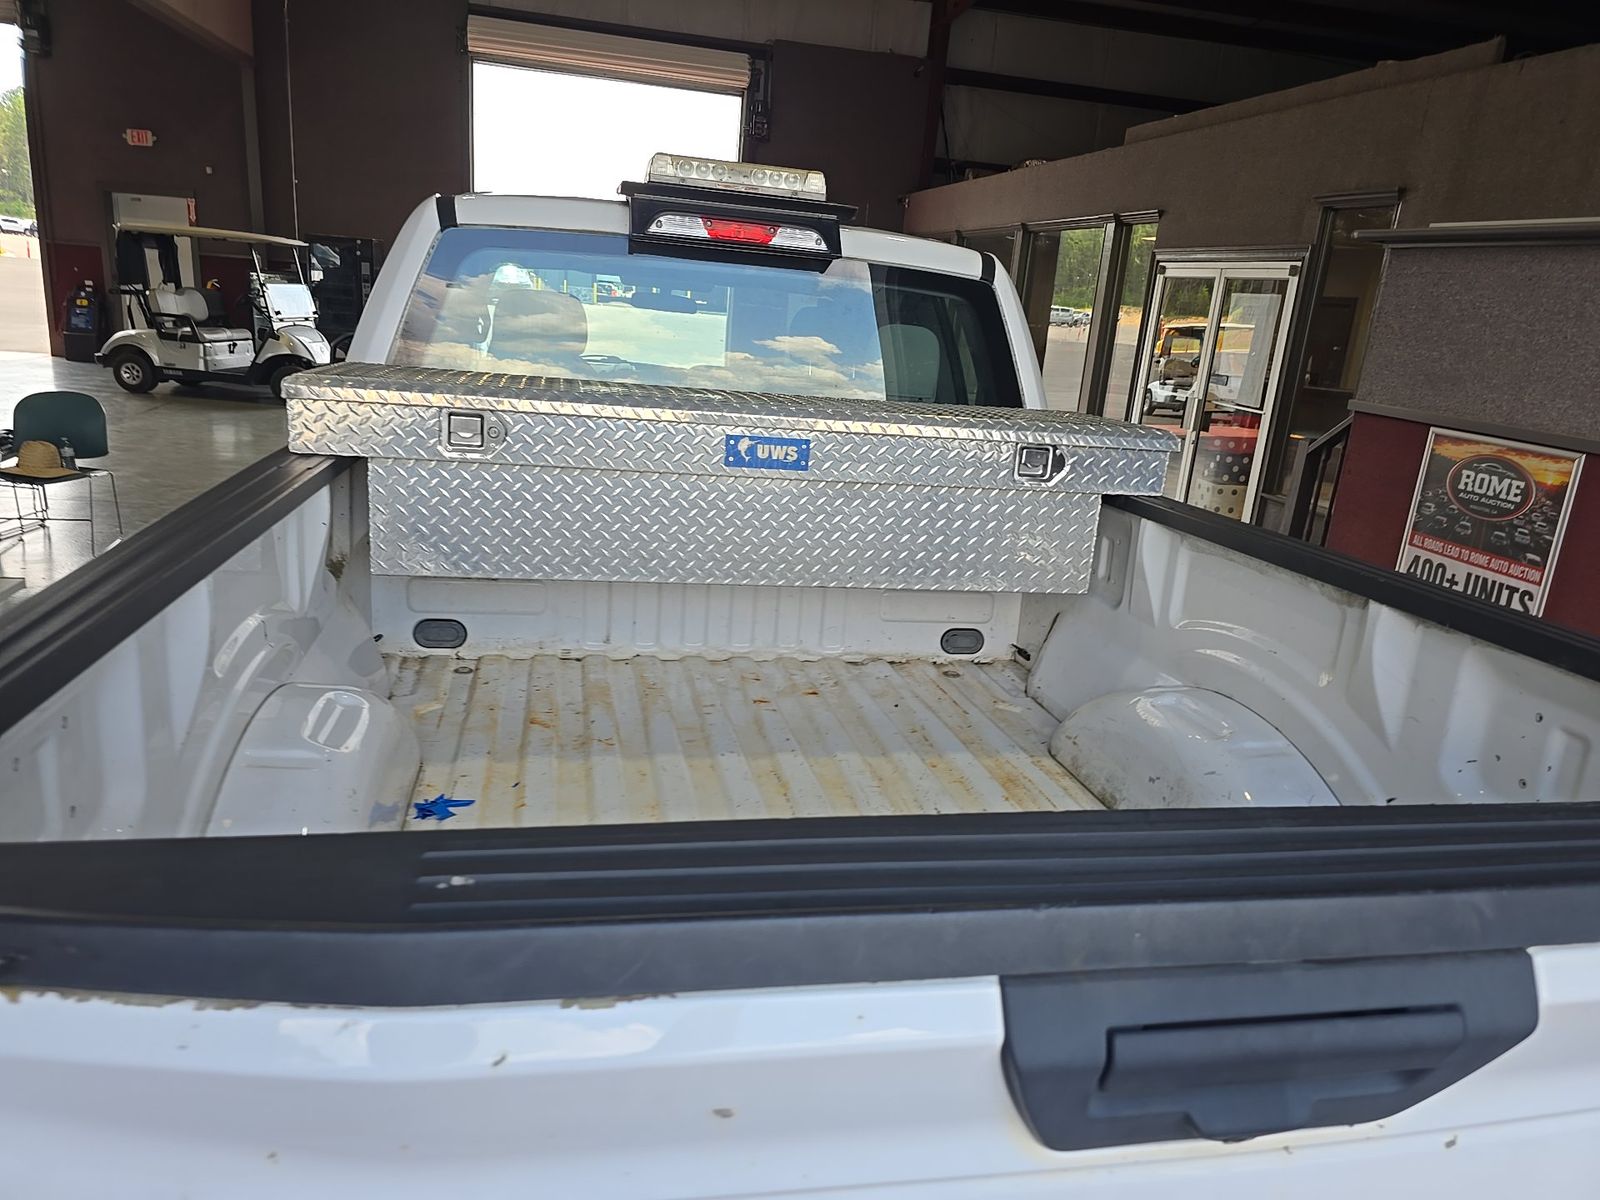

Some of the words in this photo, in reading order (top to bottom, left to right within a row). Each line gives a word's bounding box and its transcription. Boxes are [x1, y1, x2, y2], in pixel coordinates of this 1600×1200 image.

[757, 444, 798, 461] UWS
[1458, 469, 1526, 503] ROME
[1459, 492, 1480, 502] AUTO
[1480, 497, 1515, 510] AUCTION
[1412, 534, 1424, 547] ALL
[1423, 537, 1444, 553] ROADS
[1443, 543, 1460, 558] LEAD
[1460, 548, 1470, 561] TO
[1469, 551, 1490, 568] ROME
[1488, 557, 1509, 573] AUTO
[1507, 563, 1542, 583] AUCTION
[1463, 571, 1534, 613] UNITS
